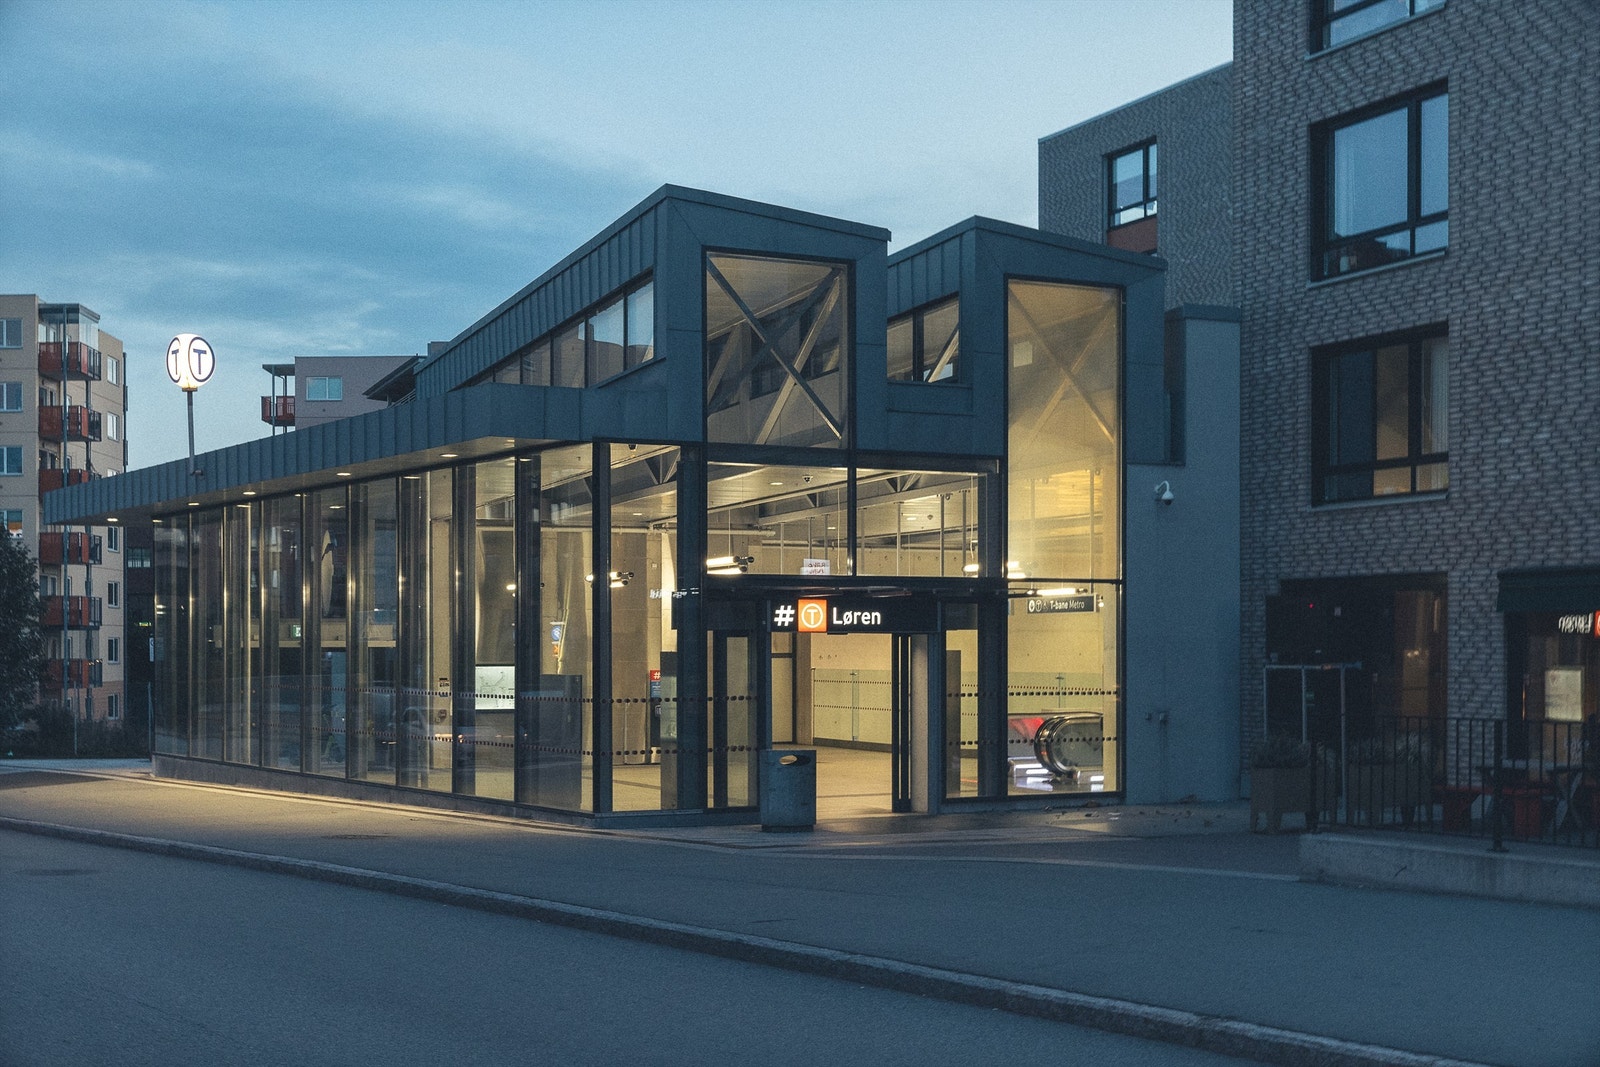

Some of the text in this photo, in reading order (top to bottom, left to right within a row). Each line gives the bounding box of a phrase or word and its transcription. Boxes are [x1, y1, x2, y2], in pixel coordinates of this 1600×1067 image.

[192, 348, 207, 375] T
[1049, 600, 1068, 610] T-bane
[1069, 600, 1085, 610] Metro
[833, 607, 881, 626] Løren
